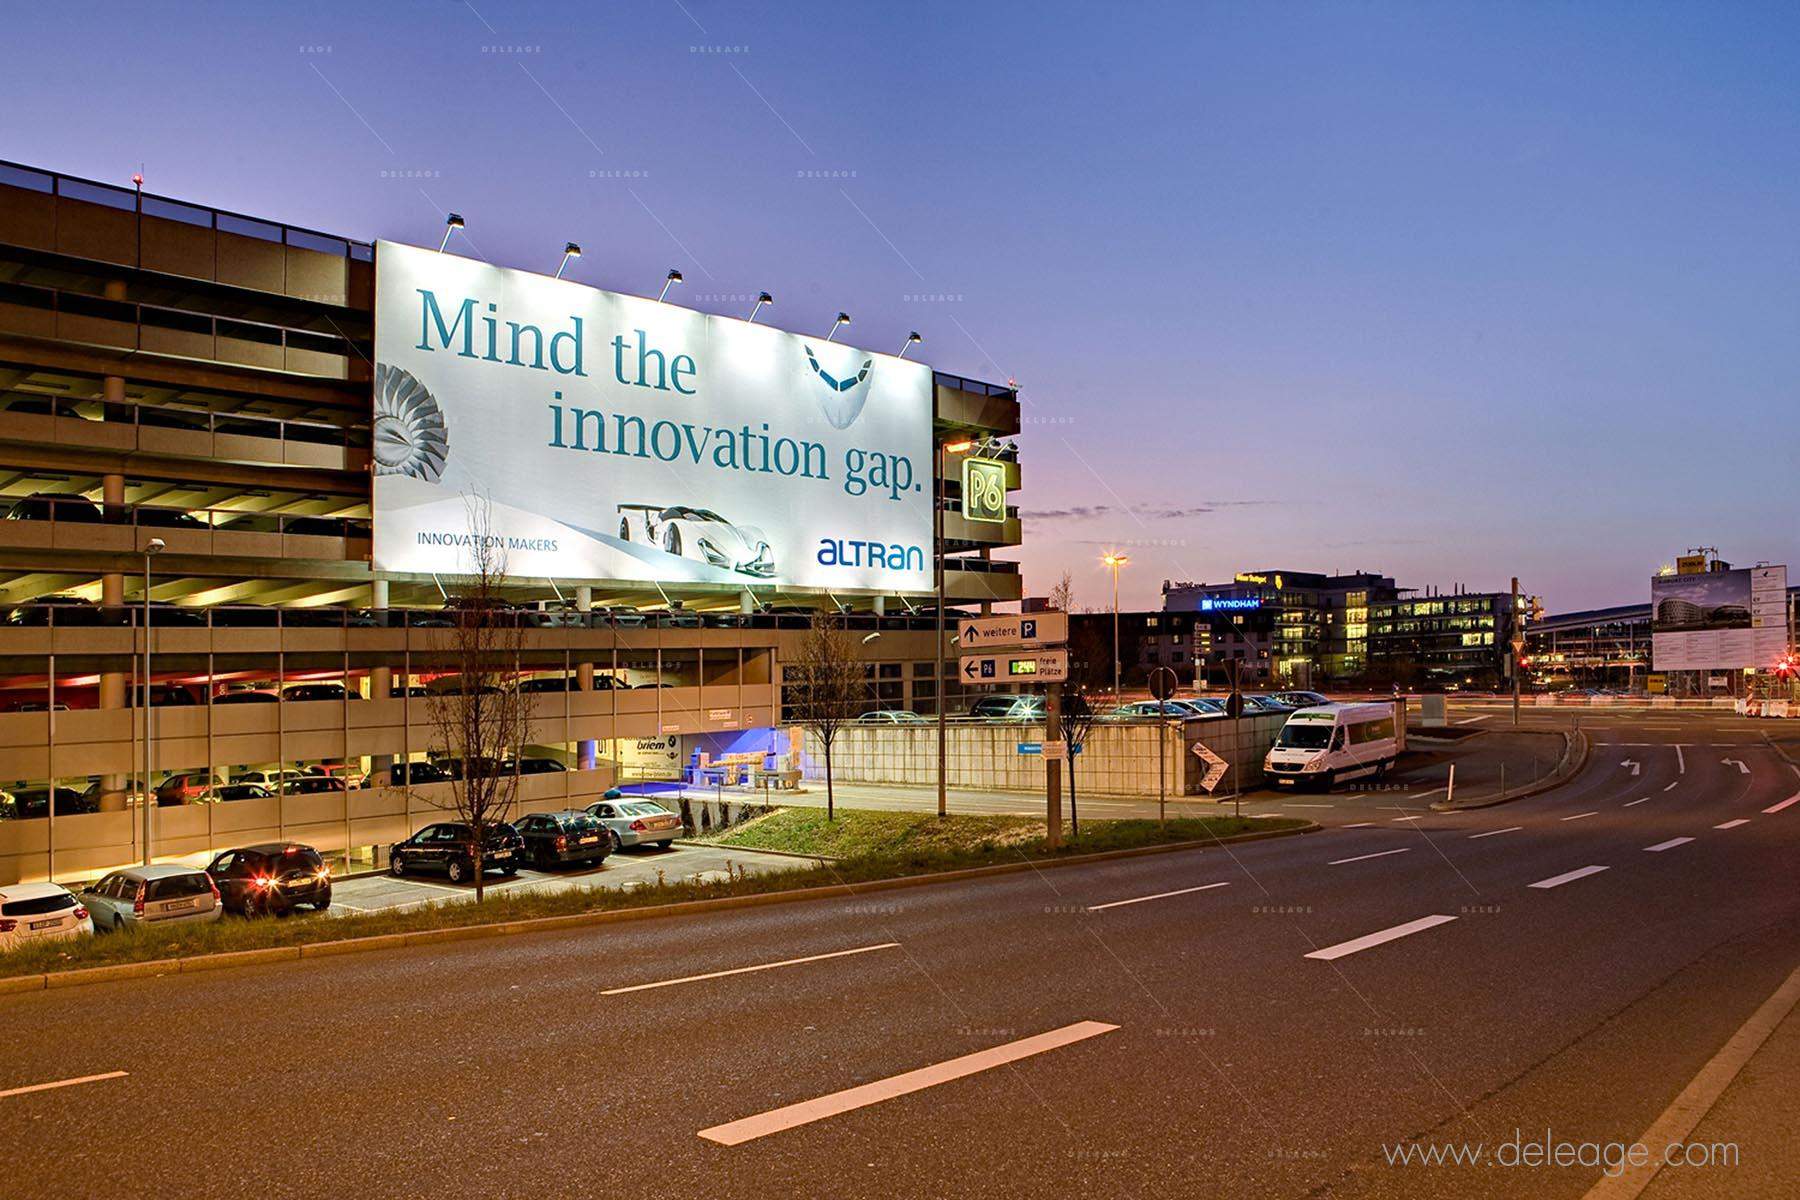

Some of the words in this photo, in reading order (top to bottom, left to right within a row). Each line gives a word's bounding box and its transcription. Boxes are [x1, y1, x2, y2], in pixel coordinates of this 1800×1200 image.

[416, 289, 588, 377] Mind
[610, 329, 697, 395] the
[548, 391, 830, 481] innovation
[845, 446, 922, 501] gap.
[970, 469, 1002, 512] P6
[417, 531, 505, 551] INNOVATION
[507, 536, 558, 552] MAKERS
[1213, 599, 1260, 609] WYNDHAM
[982, 627, 1017, 637] weitere
[1039, 656, 1057, 665] freie
[637, 740, 666, 751] briem
